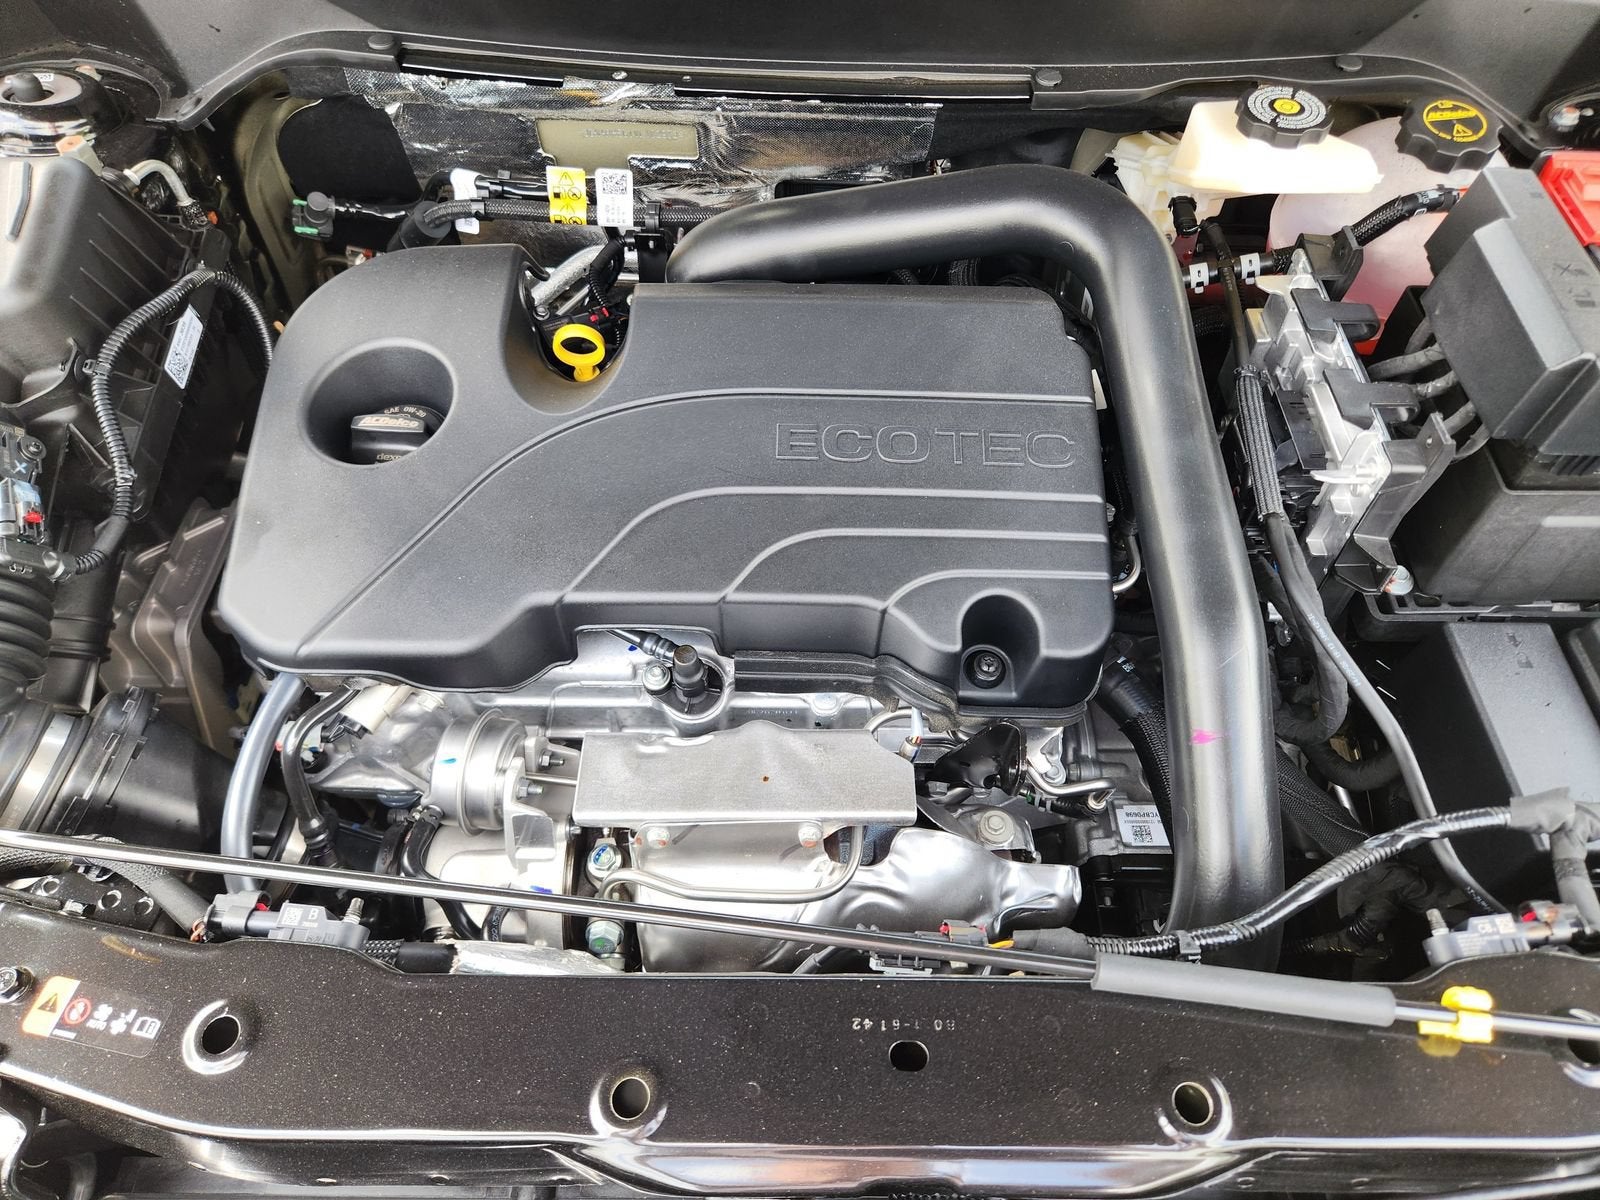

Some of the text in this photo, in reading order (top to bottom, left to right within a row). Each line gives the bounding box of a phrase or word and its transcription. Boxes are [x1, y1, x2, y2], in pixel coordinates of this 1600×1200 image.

[384, 406, 427, 418] SAE 0W-20
[357, 416, 420, 427] ACDelco
[775, 422, 1075, 469] ECOTEC
[308, 907, 320, 921] B
